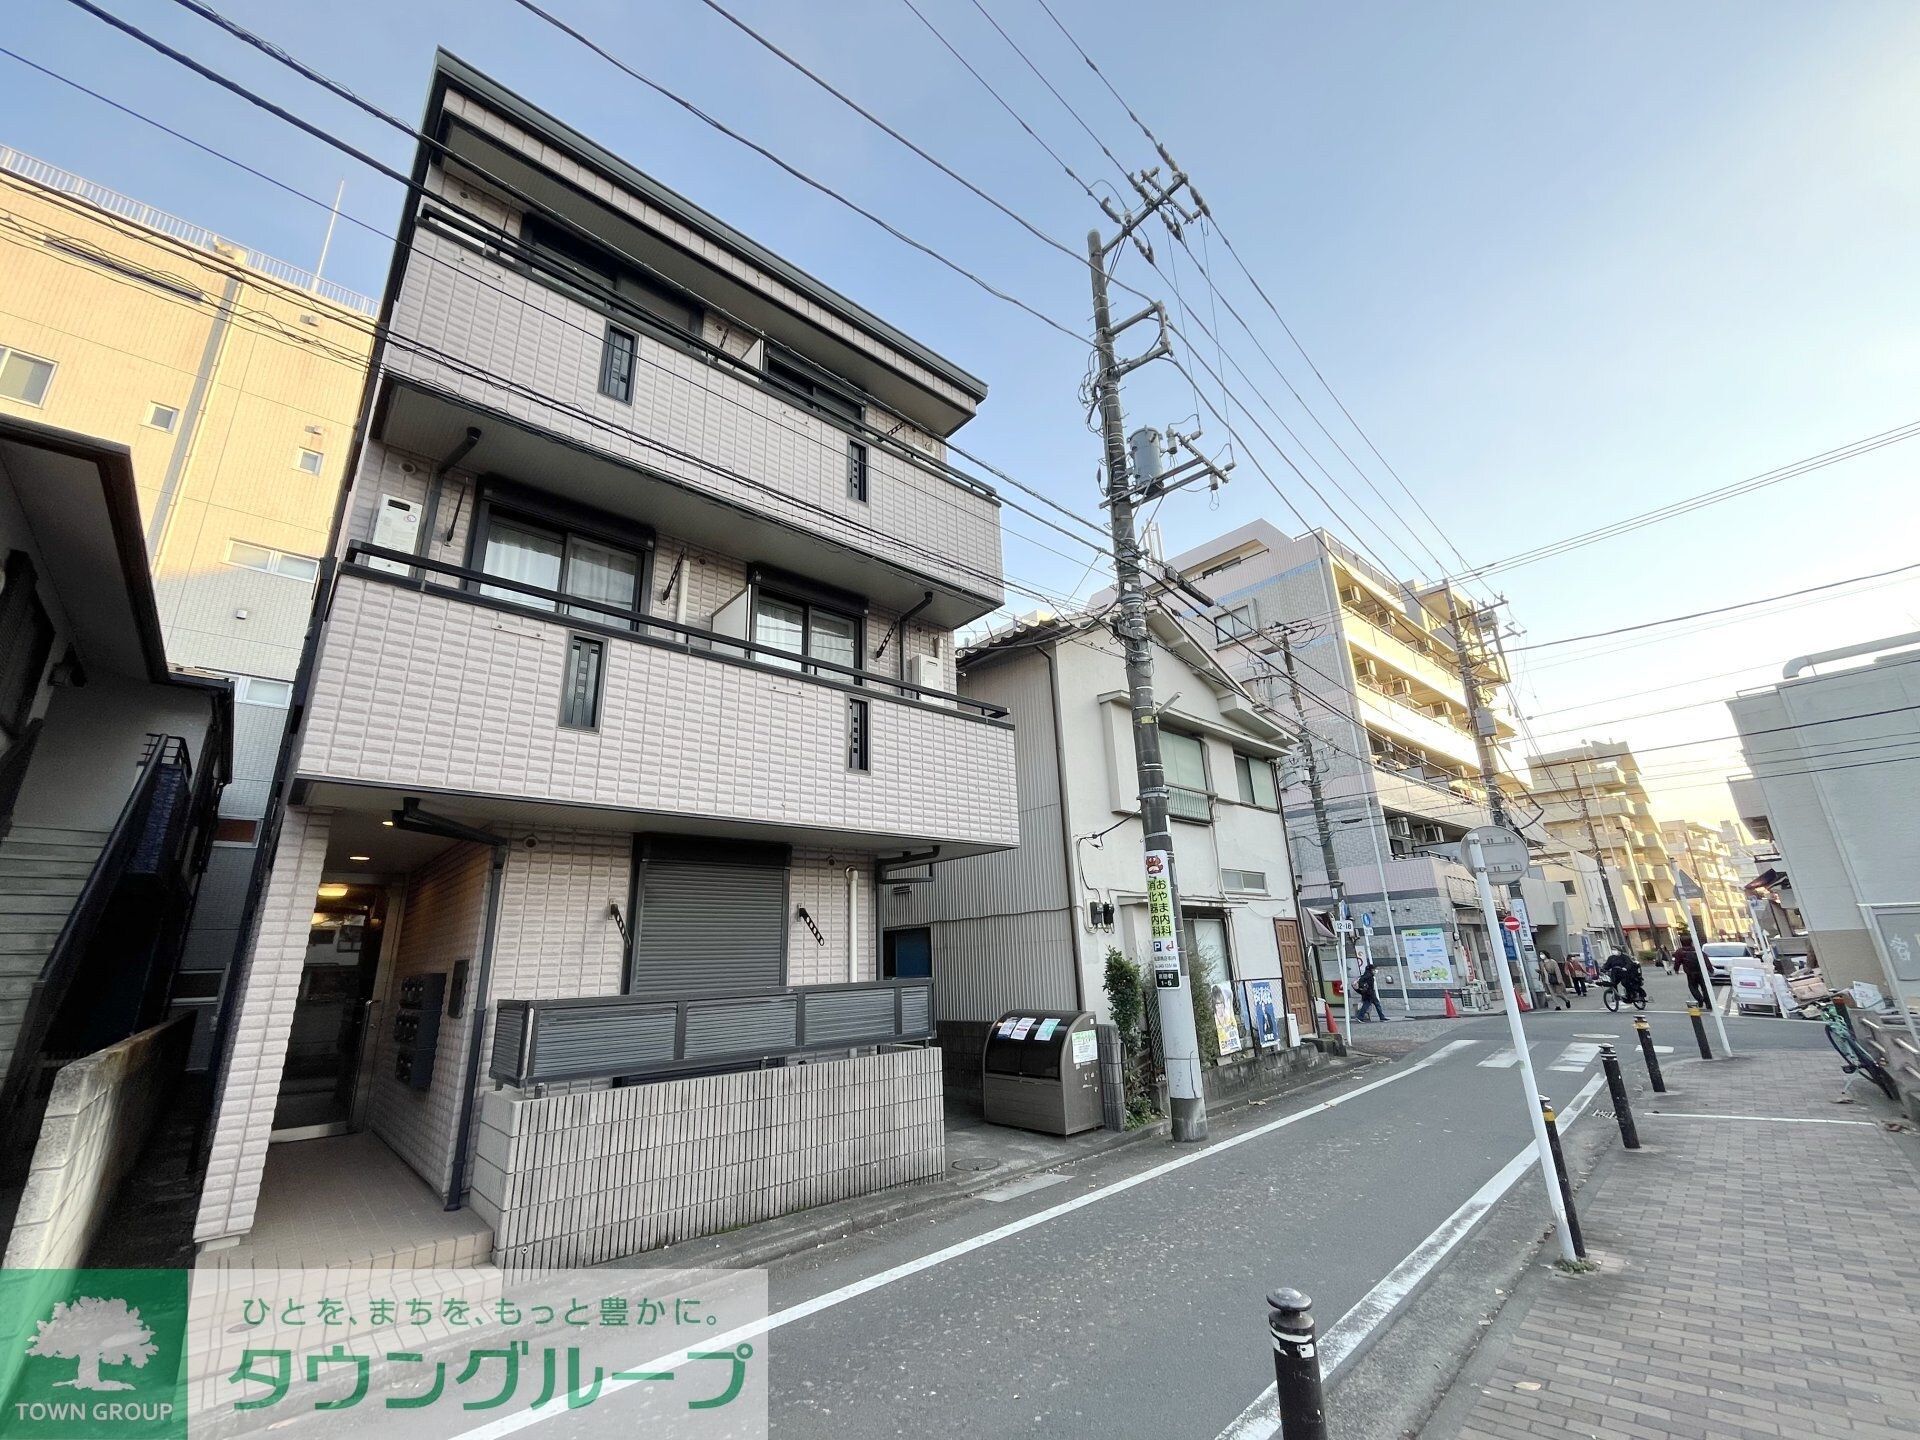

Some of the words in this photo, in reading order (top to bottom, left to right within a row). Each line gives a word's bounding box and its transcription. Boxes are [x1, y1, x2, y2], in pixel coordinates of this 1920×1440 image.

[1147, 880, 1161, 937] 消化器内科
[1156, 879, 1172, 936] おやま内科
